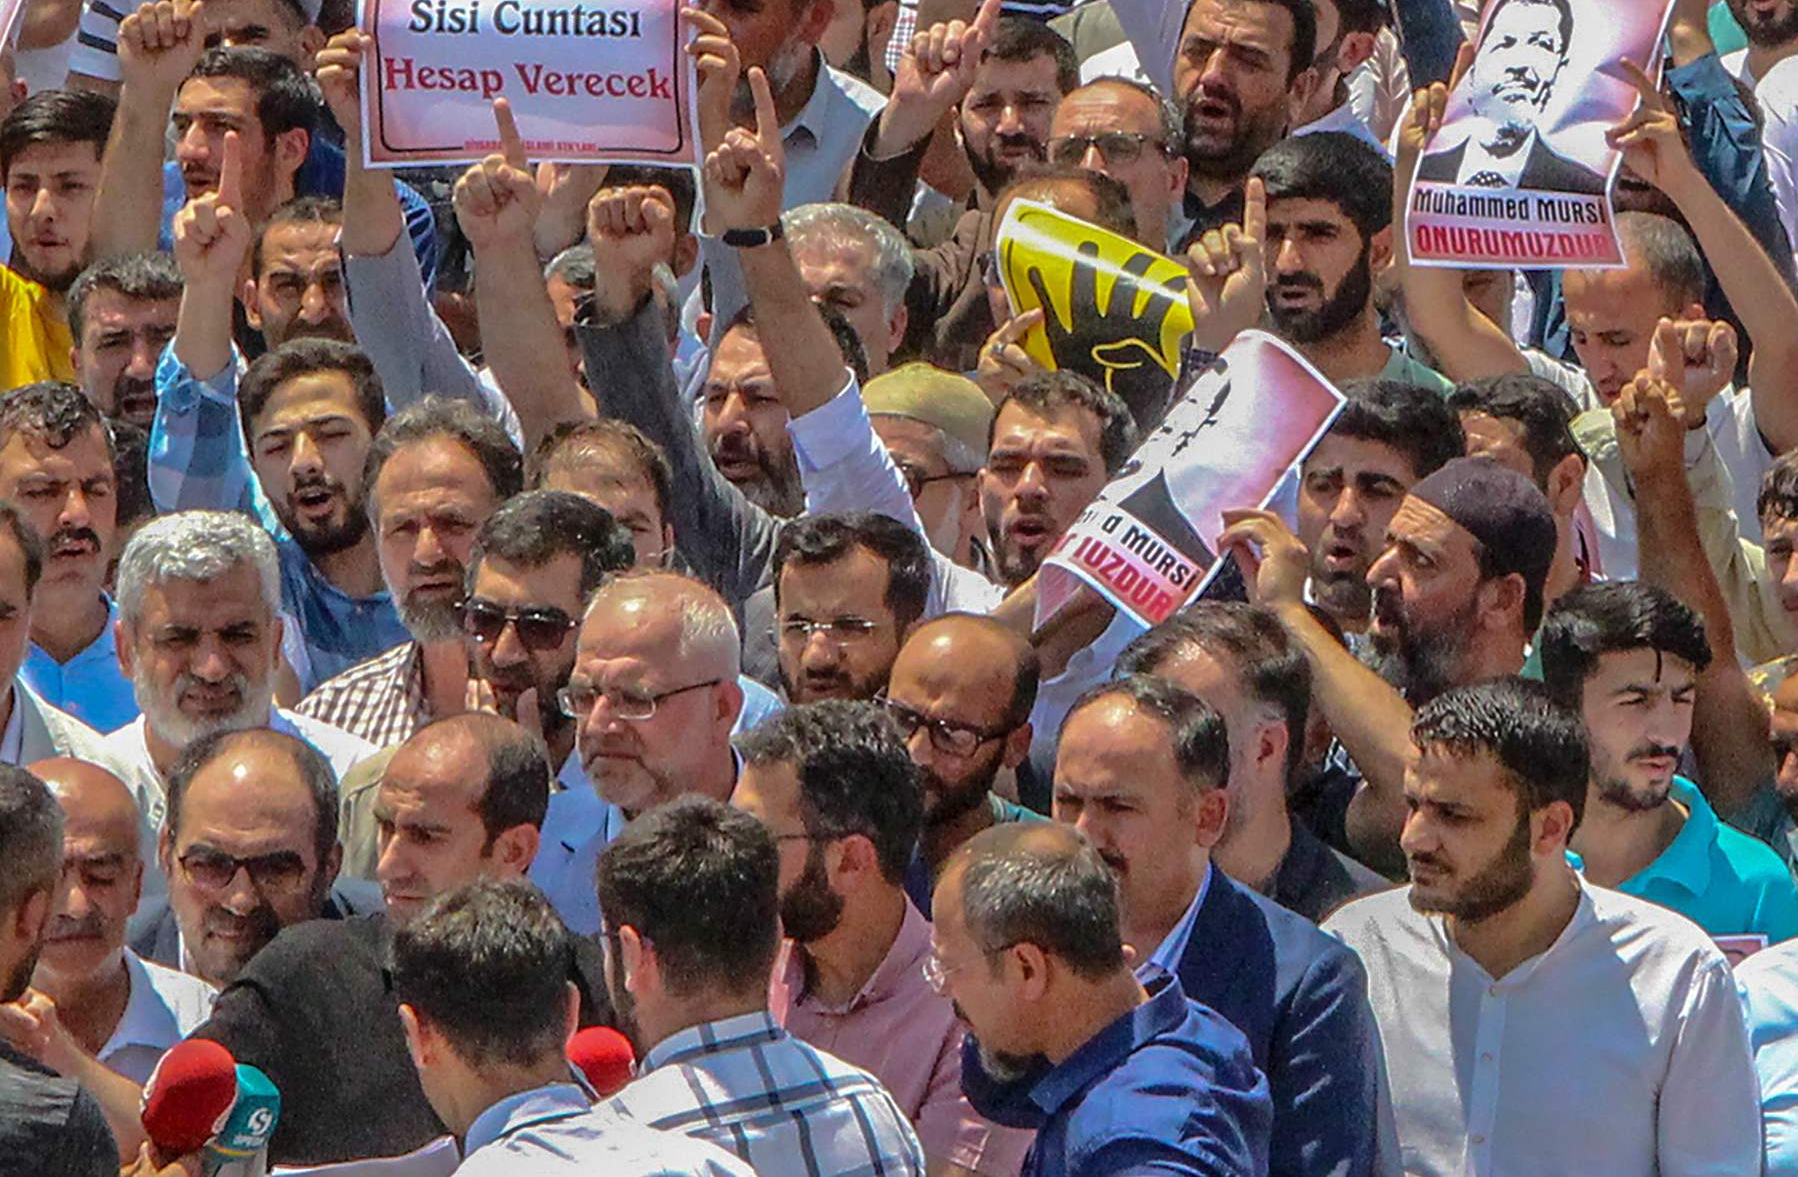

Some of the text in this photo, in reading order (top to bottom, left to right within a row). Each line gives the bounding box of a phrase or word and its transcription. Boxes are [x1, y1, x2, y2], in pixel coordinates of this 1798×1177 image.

[492, 0, 642, 39] Cuntası
[383, 57, 673, 100] Hesap Verecek
[1414, 188, 1531, 221] Muhammed
[1416, 224, 1609, 259] ONURUMUZDUR
